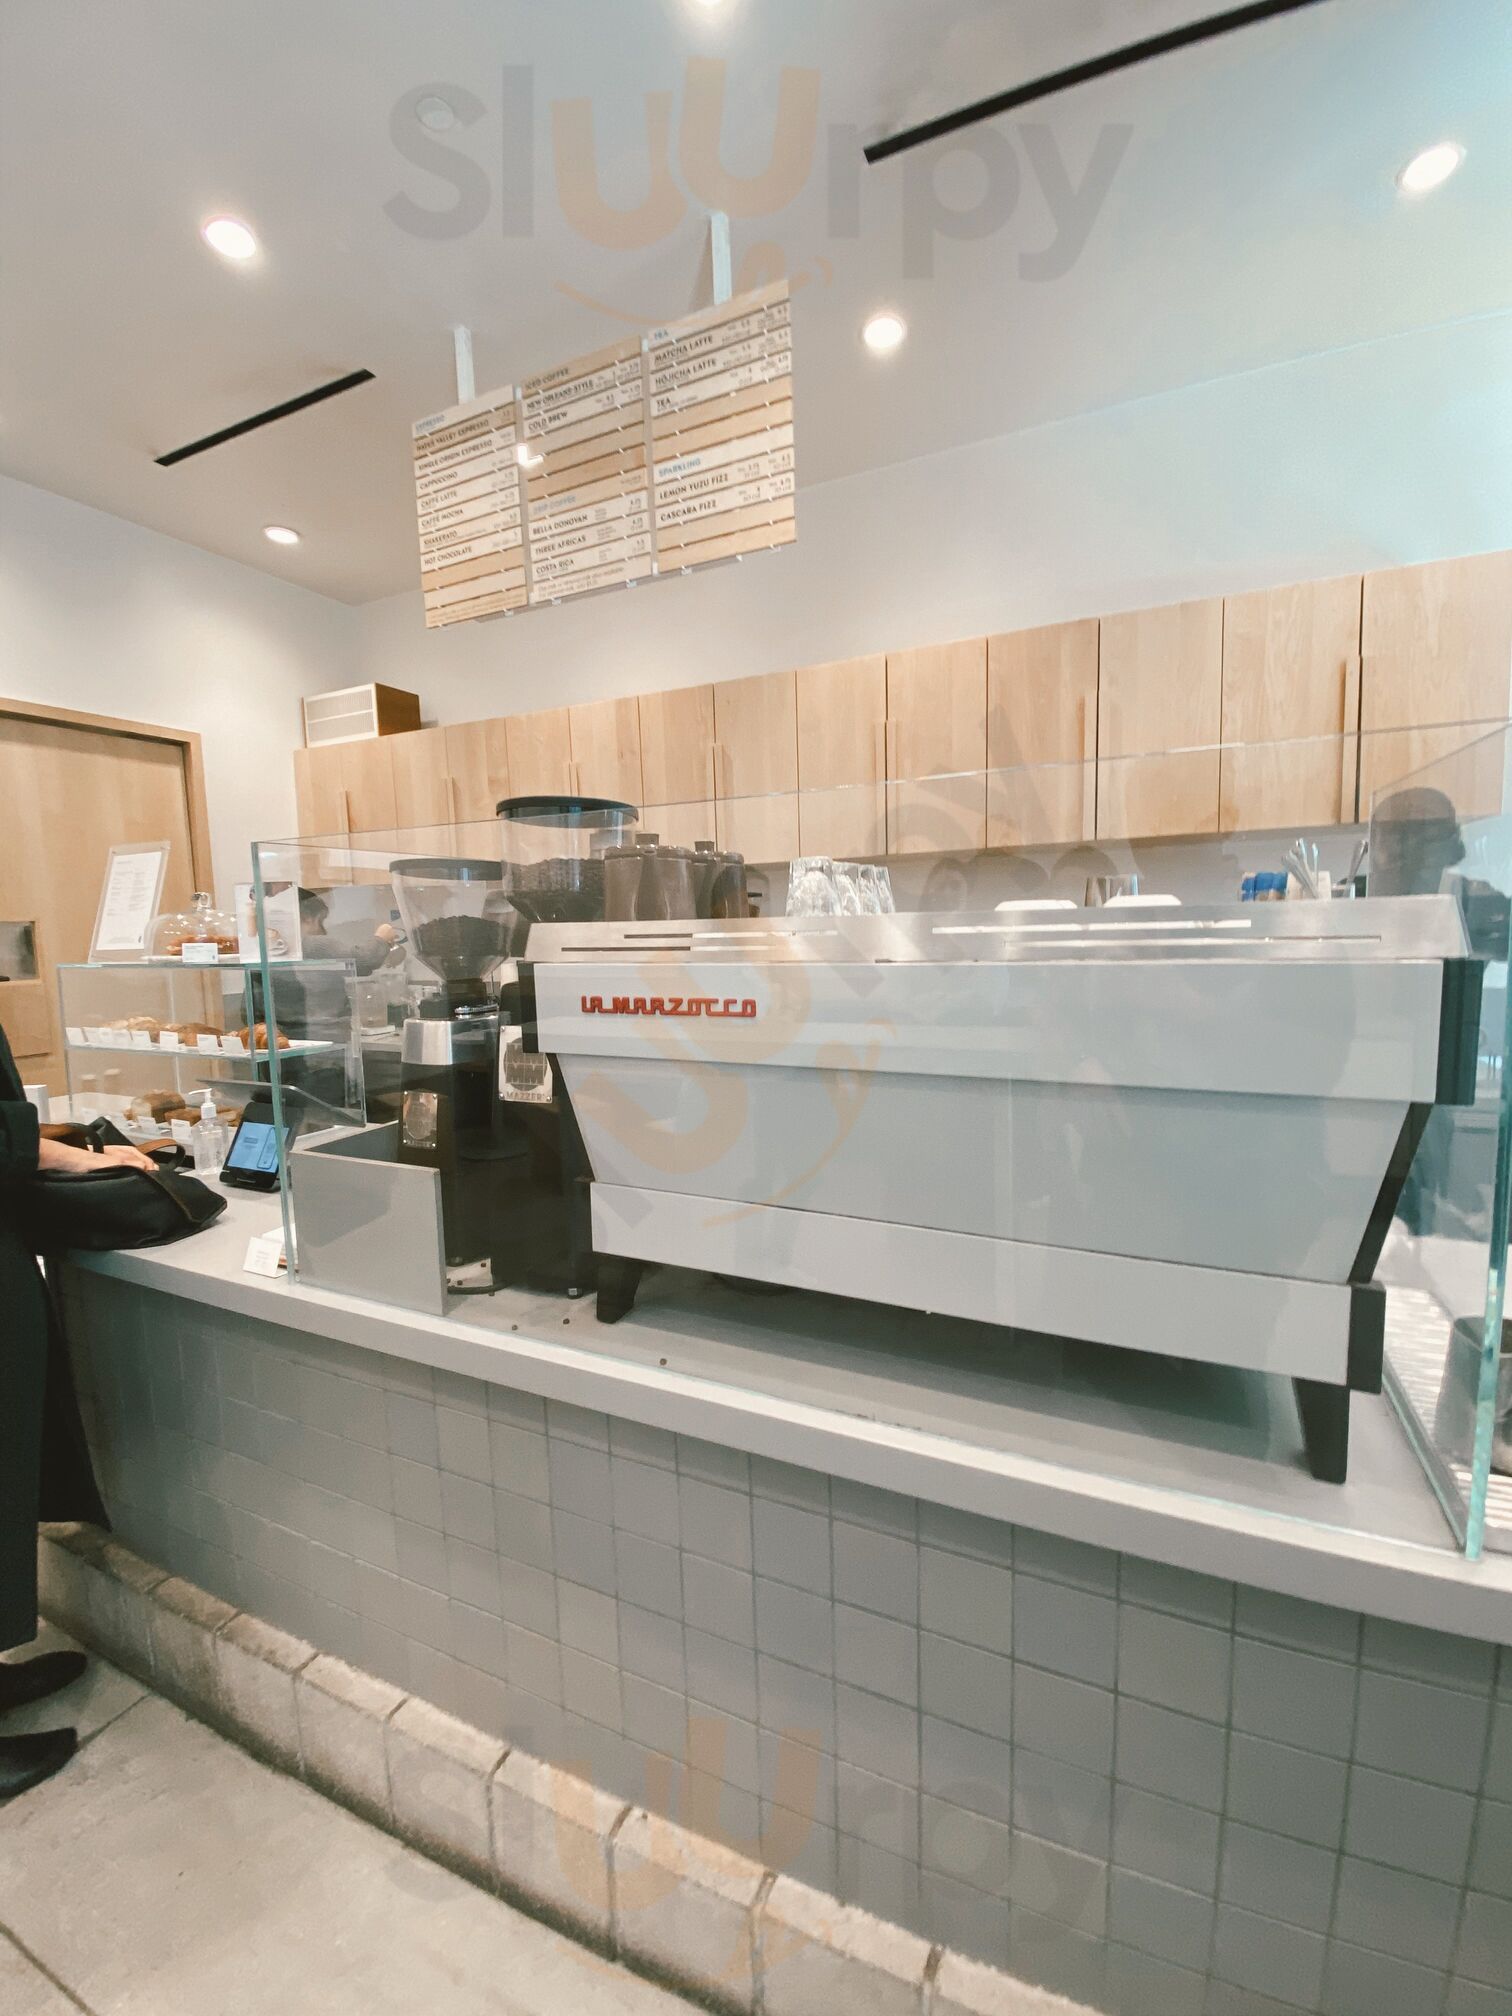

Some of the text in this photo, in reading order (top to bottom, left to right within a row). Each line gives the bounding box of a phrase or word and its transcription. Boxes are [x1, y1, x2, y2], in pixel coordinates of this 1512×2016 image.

[655, 345, 688, 362] MATCHA
[690, 336, 713, 349] LATTE
[693, 358, 716, 372] LATTE
[528, 418, 547, 433] COLD
[548, 411, 568, 424] BREW
[659, 458, 701, 477] SPARKLING
[659, 486, 687, 499] LEMON
[689, 479, 709, 491] YUZU
[711, 473, 728, 485] FIZZ
[660, 505, 697, 521] CASCARA
[699, 499, 717, 511] FIZZ
[533, 523, 552, 535] BELLA
[554, 514, 588, 530] DONOVAN
[535, 544, 555, 555] THREE
[557, 535, 586, 549] AFRICAS
[536, 563, 557, 574] COSTA
